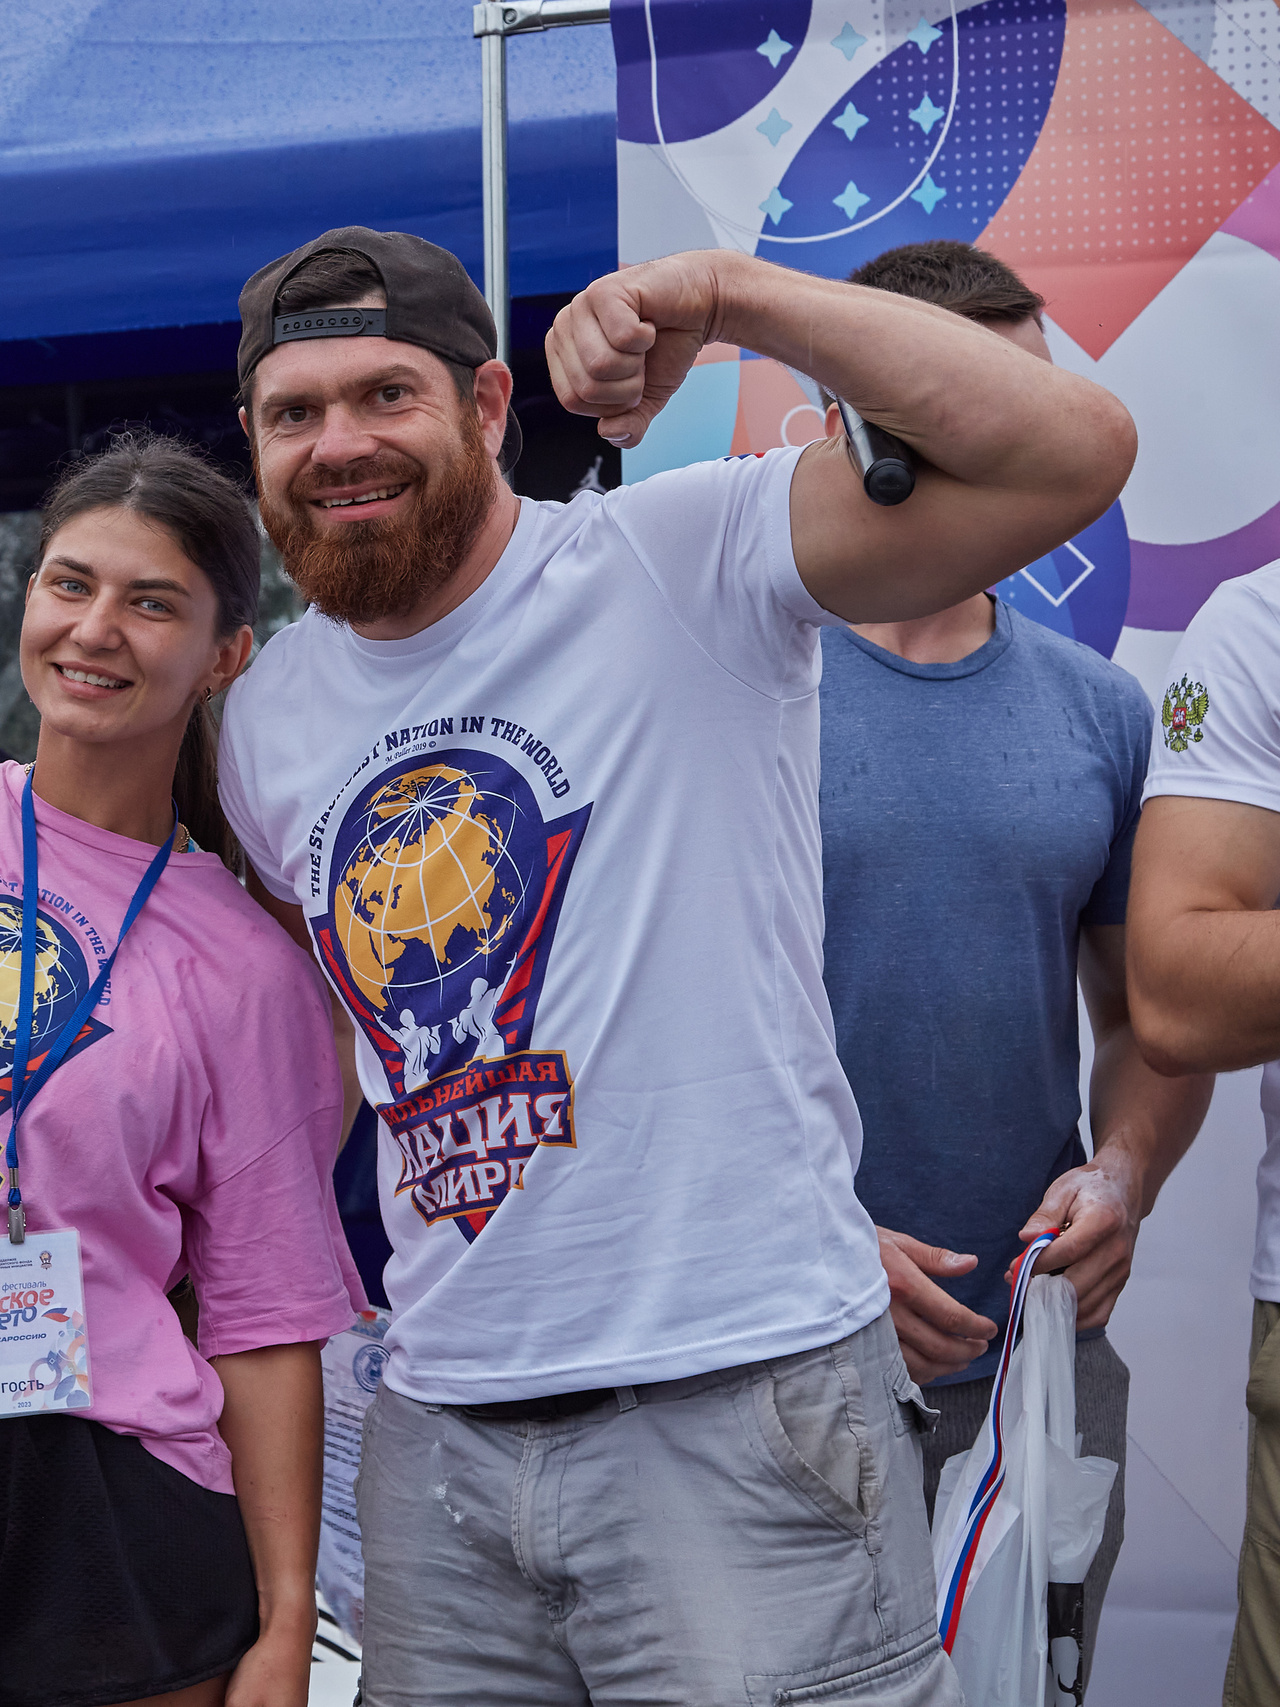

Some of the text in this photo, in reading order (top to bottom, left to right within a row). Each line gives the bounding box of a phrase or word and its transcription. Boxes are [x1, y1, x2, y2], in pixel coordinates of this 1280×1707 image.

[311, 716, 570, 897] THE NATION IN THE WORLD
[72, 912, 89, 927] IN
[85, 927, 106, 954] THE
[380, 1061, 559, 1127] ИЛЬНЕЙШАЯ
[2, 1281, 47, 1292] фестиваль
[1, 1380, 44, 1393] ГОСТЬ
[17, 1401, 31, 1409] 2023
